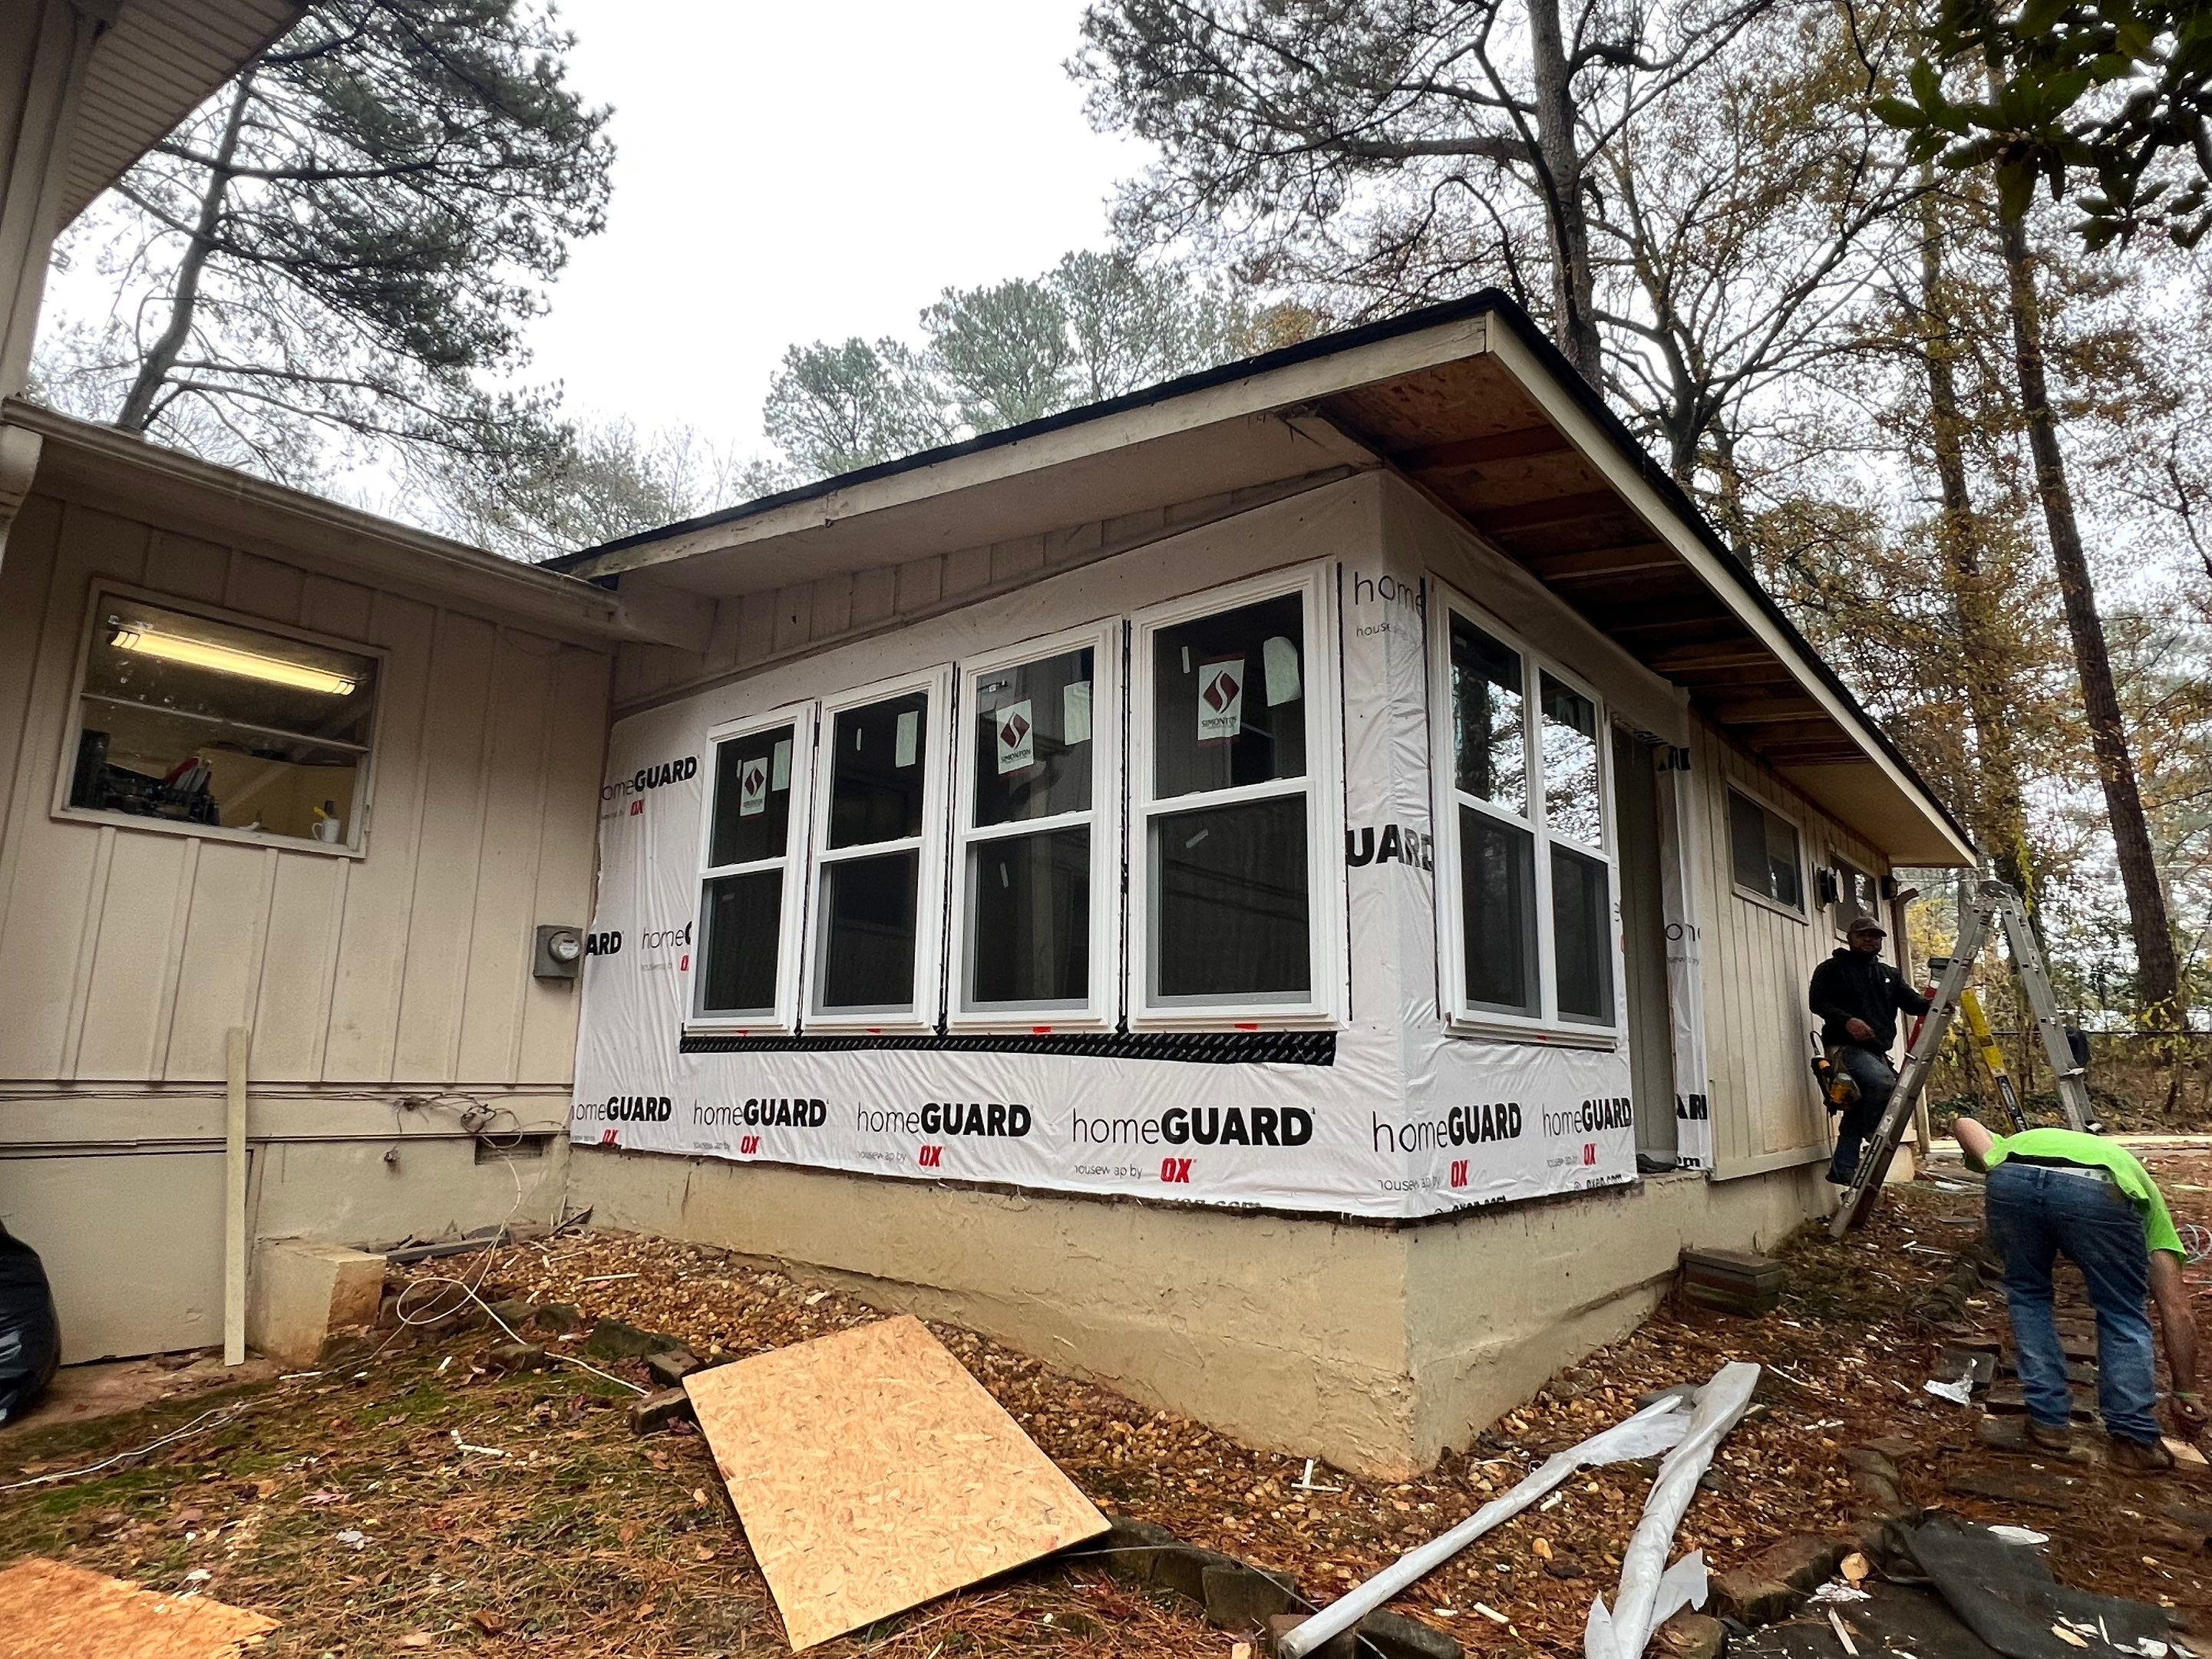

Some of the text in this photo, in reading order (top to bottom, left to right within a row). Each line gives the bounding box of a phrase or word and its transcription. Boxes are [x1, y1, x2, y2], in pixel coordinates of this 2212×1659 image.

[586, 931, 622, 955] ARD
[694, 1098, 827, 1127] homeGUARD
[857, 1101, 1032, 1137] homeGUARD
[1072, 1107, 1313, 1146] homeGUARD
[1542, 1097, 1632, 1138] homeGUARD
[1372, 1102, 1521, 1153] homeGUARD
[741, 1136, 759, 1153] OX
[919, 1145, 943, 1167] OX
[1583, 1143, 1596, 1166] OX
[1129, 1163, 1143, 1179] by
[1160, 1157, 1192, 1183] OX
[1451, 1159, 1469, 1188] OX
